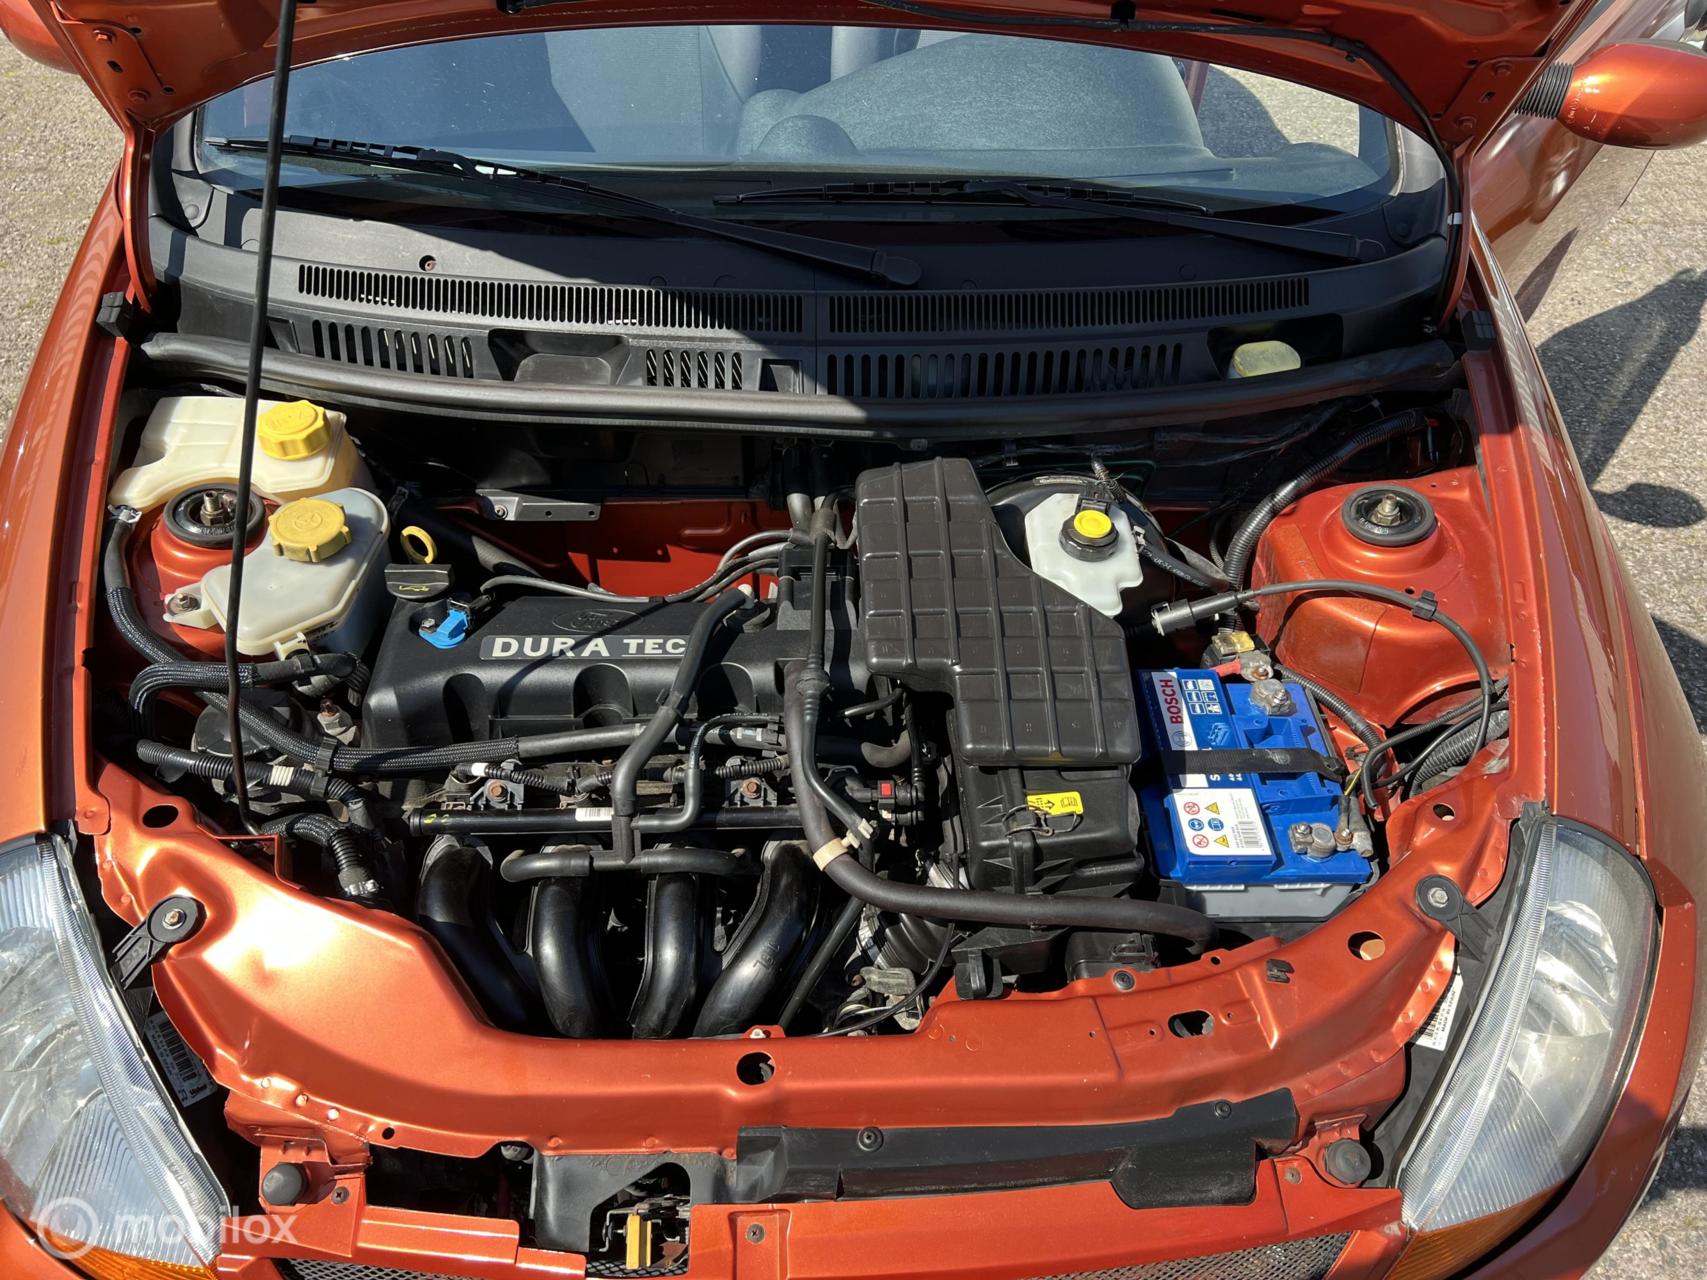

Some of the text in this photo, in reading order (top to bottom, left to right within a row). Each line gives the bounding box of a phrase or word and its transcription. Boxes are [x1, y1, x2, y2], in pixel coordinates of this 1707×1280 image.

[492, 637, 686, 657] DURA TEC
[1159, 679, 1184, 725] BOSCH
